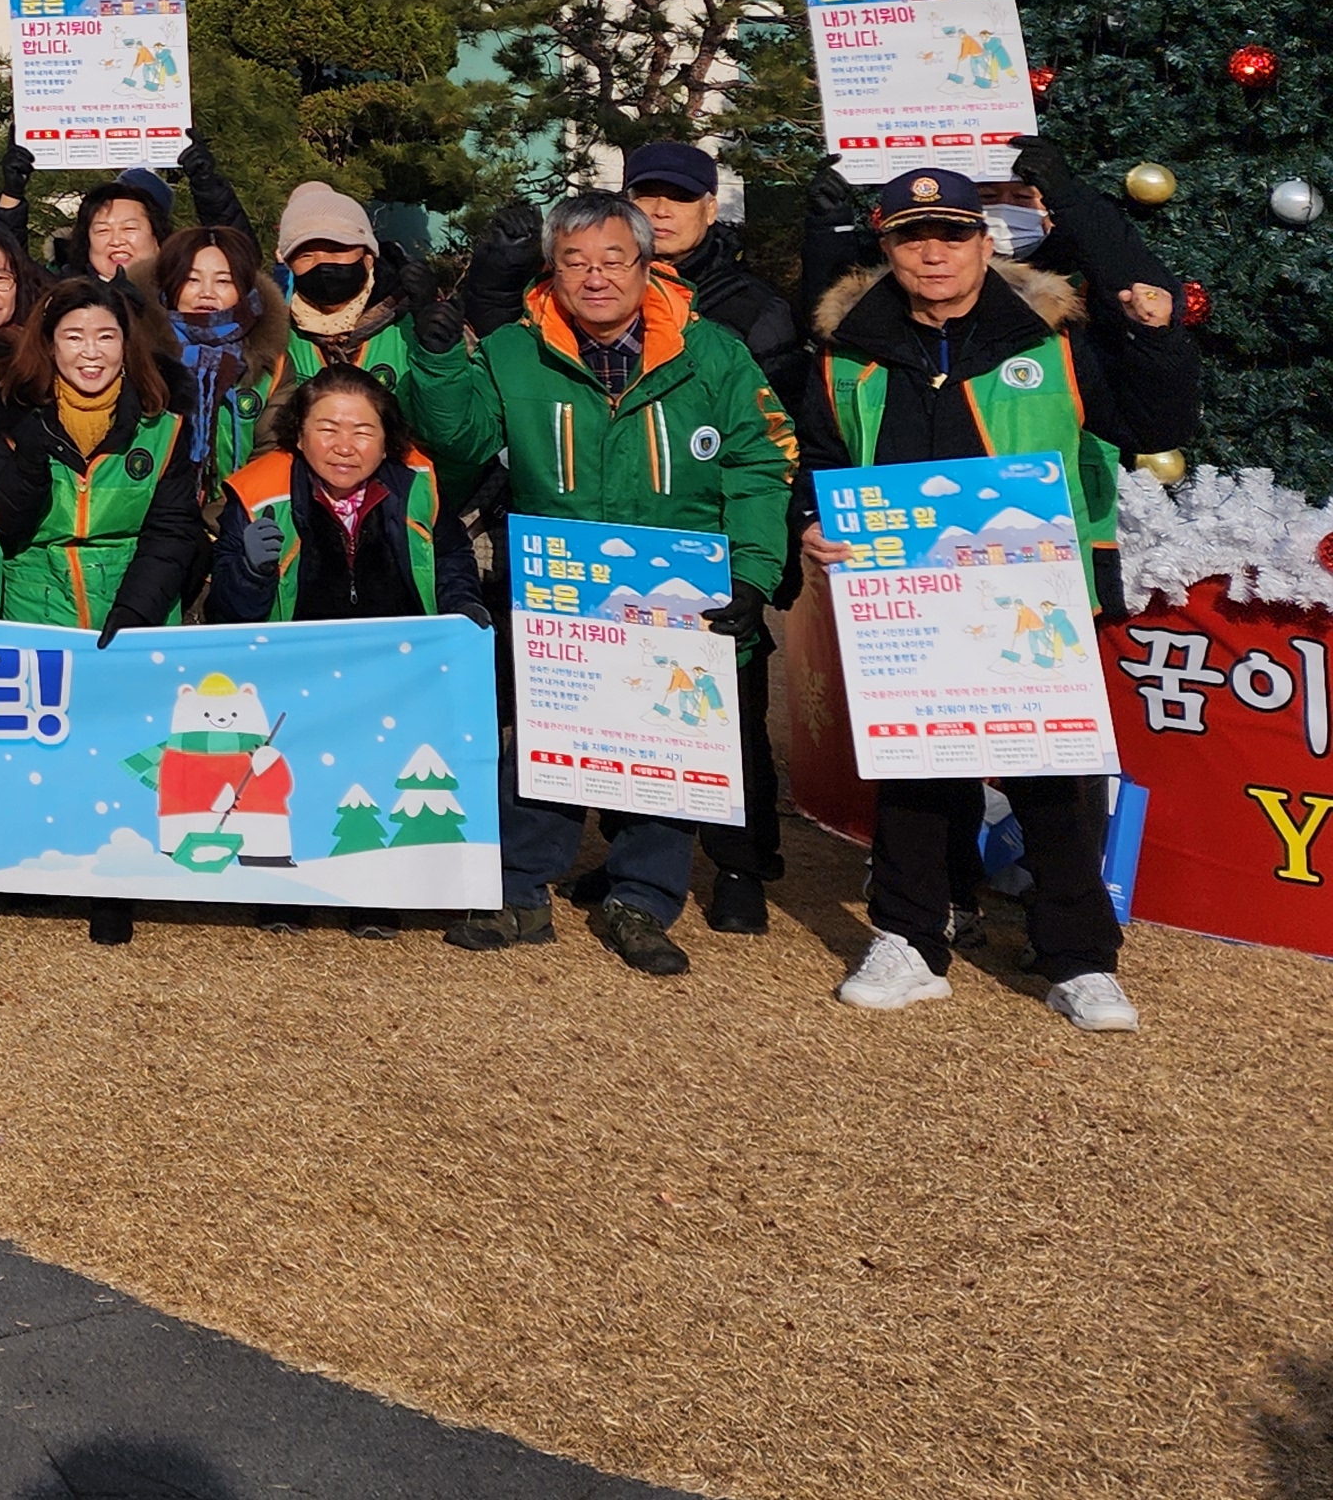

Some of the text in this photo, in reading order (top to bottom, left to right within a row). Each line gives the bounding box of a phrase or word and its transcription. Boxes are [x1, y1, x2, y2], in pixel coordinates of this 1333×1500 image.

[21, 20, 102, 37] 내가 치워야
[821, 6, 915, 28] 내가 치워야
[22, 39, 71, 55] 합니다.
[824, 29, 882, 49] 합니다.
[833, 485, 890, 509] 내 집,
[836, 506, 938, 533] 내 점포 앞
[523, 533, 571, 559] 내 집,
[840, 536, 906, 568] 눈은
[523, 556, 611, 584] 내 점포 앞
[524, 580, 579, 613] 눈은
[846, 573, 963, 598] 내가 치워야
[850, 599, 922, 622] 합니다.
[526, 617, 627, 646] 내가 치워야
[527, 639, 588, 663] 합니다.
[1117, 624, 1333, 760] 꿈이
